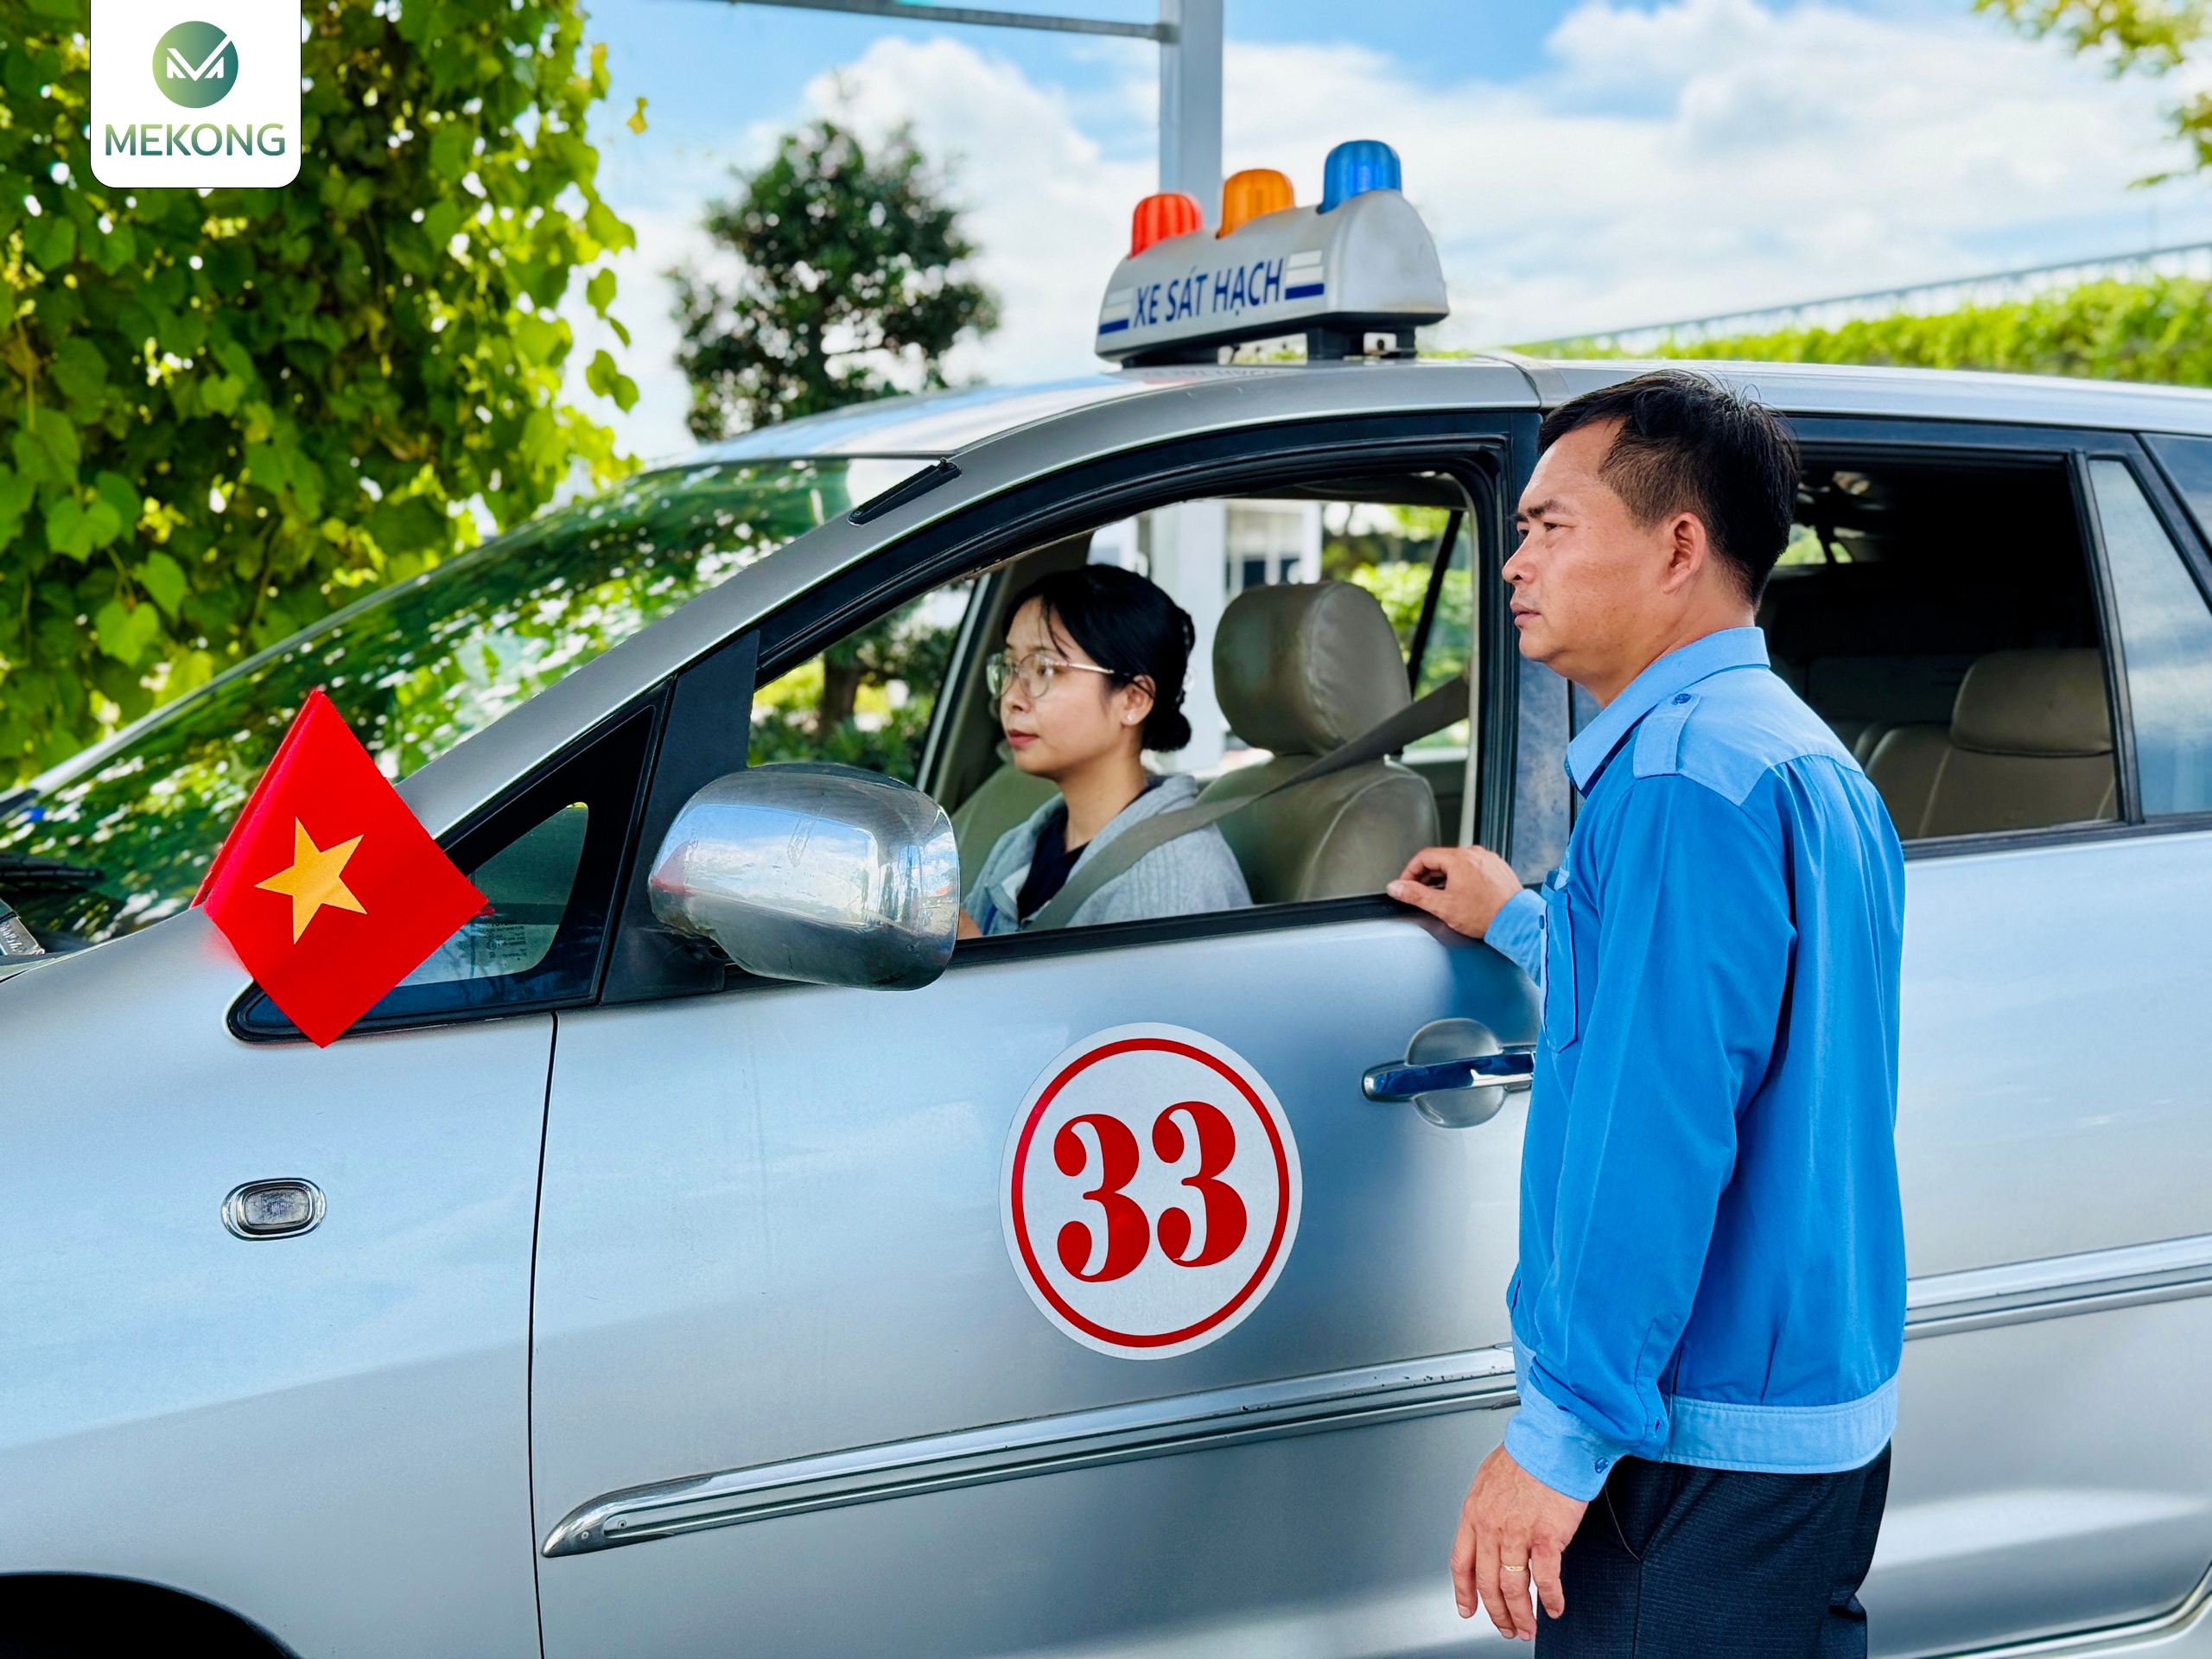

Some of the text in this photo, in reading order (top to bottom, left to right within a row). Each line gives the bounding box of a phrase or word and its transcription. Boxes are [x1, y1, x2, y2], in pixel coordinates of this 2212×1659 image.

[1134, 258, 1283, 327] XE SÁT HẠCH
[1053, 1101, 1248, 1282] 33
